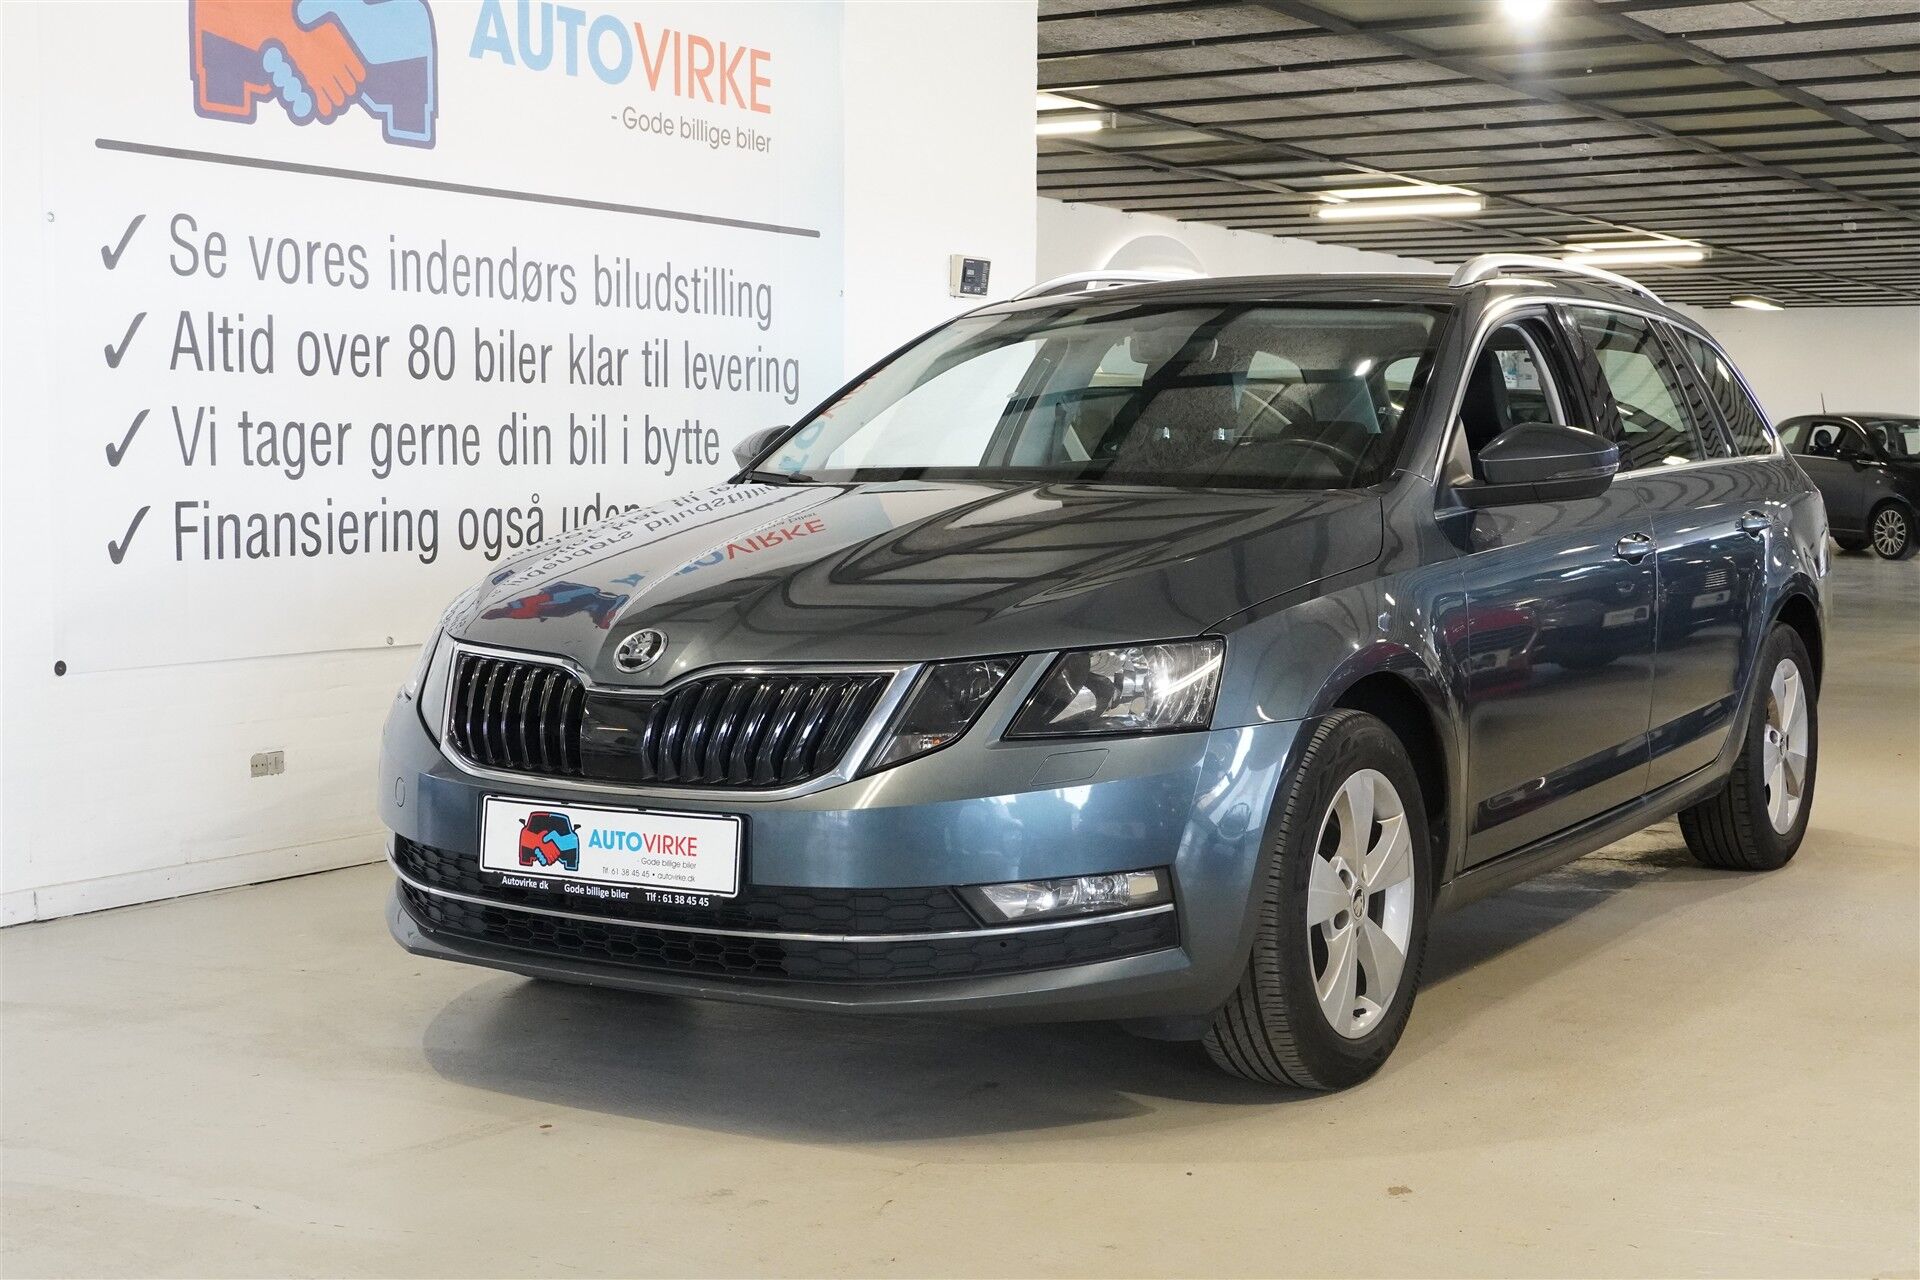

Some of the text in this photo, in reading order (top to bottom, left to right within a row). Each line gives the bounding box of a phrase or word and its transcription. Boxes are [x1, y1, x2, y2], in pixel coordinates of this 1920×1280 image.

[469, 0, 771, 114] AUTOVIRKE
[622, 106, 674, 136] Gode
[680, 116, 731, 149] billige
[736, 127, 772, 153] biler
[170, 213, 772, 331] Se vores indendørs biludstilling
[170, 311, 800, 405] Altid over 80 biler klar til levering
[172, 406, 217, 467] Vi
[238, 411, 353, 480] tager
[371, 425, 481, 480] gerne
[498, 412, 552, 466] din
[570, 413, 607, 466] bil
[622, 415, 628, 465] i
[645, 414, 720, 476] bytte
[175, 499, 439, 564] Finansiering
[458, 493, 545, 571] også
[588, 829, 698, 857] AUTOVIRKE
[621, 868, 630, 876] 38
[631, 869, 640, 877] 45
[642, 870, 650, 878] 45
[641, 857, 697, 870] Gode billige biler
[501, 876, 549, 890] Autovirke dk
[564, 883, 630, 899] Gode billige biler
[662, 893, 673, 904] 61
[674, 894, 685, 905] 38
[686, 896, 697, 906] 45
[698, 897, 709, 907] 45
